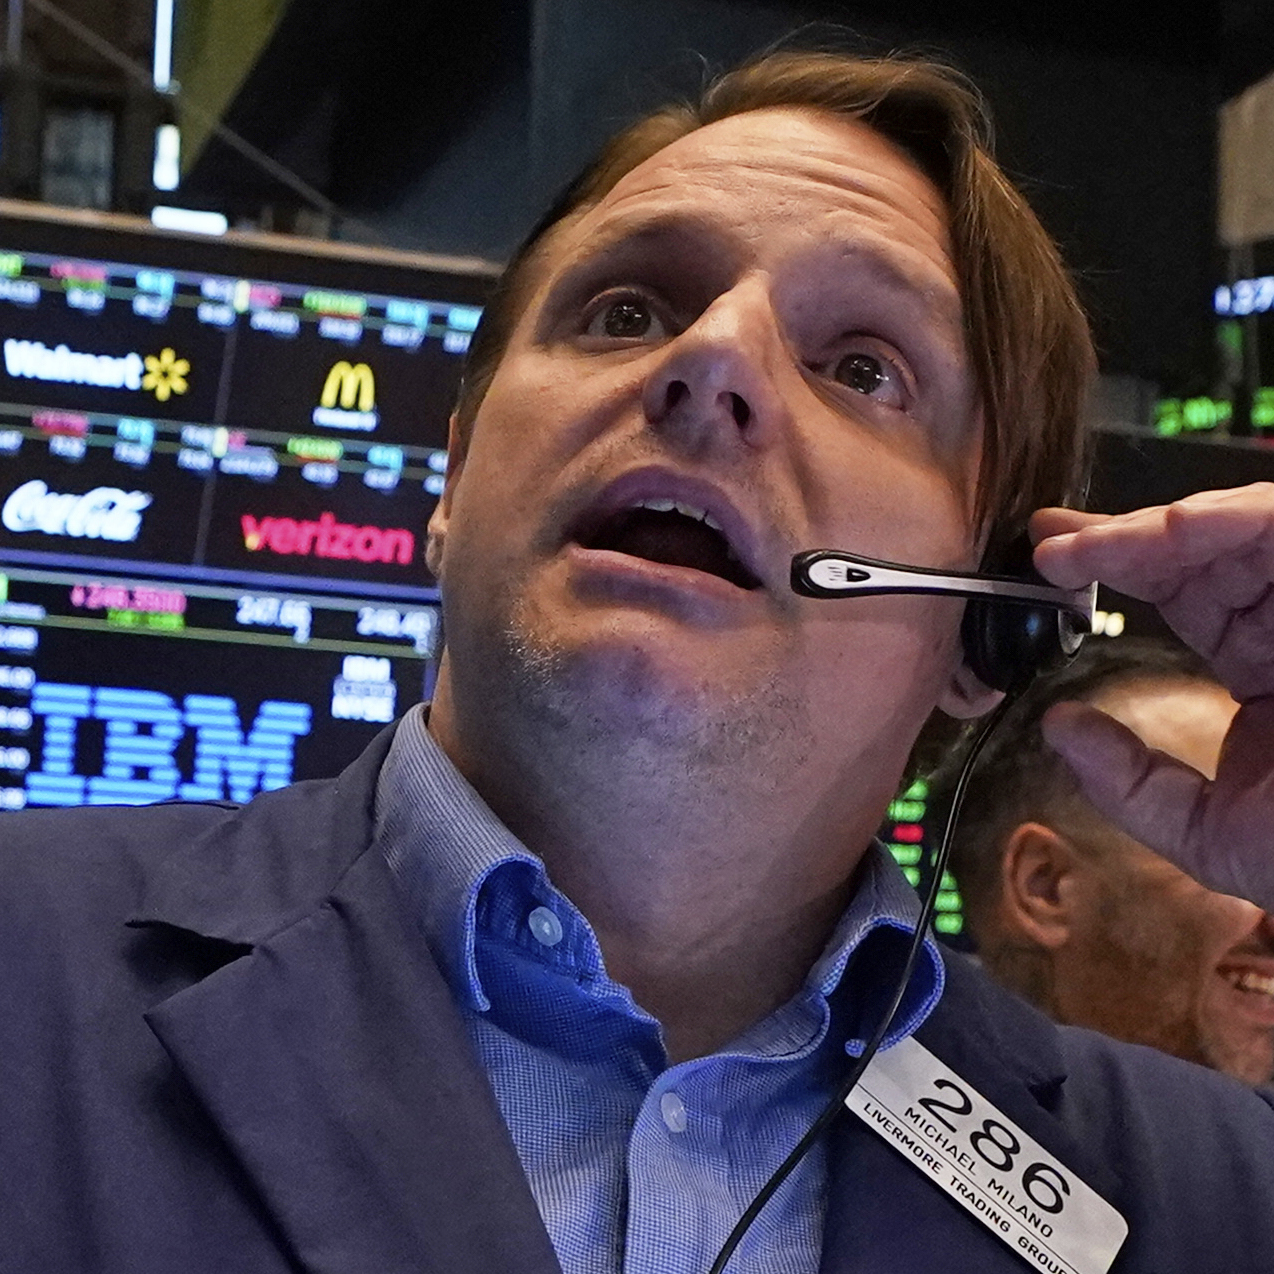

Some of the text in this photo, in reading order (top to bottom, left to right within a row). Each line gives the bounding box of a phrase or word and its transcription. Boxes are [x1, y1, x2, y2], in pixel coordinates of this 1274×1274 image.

[242, 512, 413, 565] verizon
[26, 682, 311, 806] IBM
[863, 1103, 944, 1175] LIVERMORE
[950, 1176, 1010, 1233] TRADING
[904, 1107, 1053, 1239] MICHAEL MILANO
[917, 1079, 1071, 1214] 286
